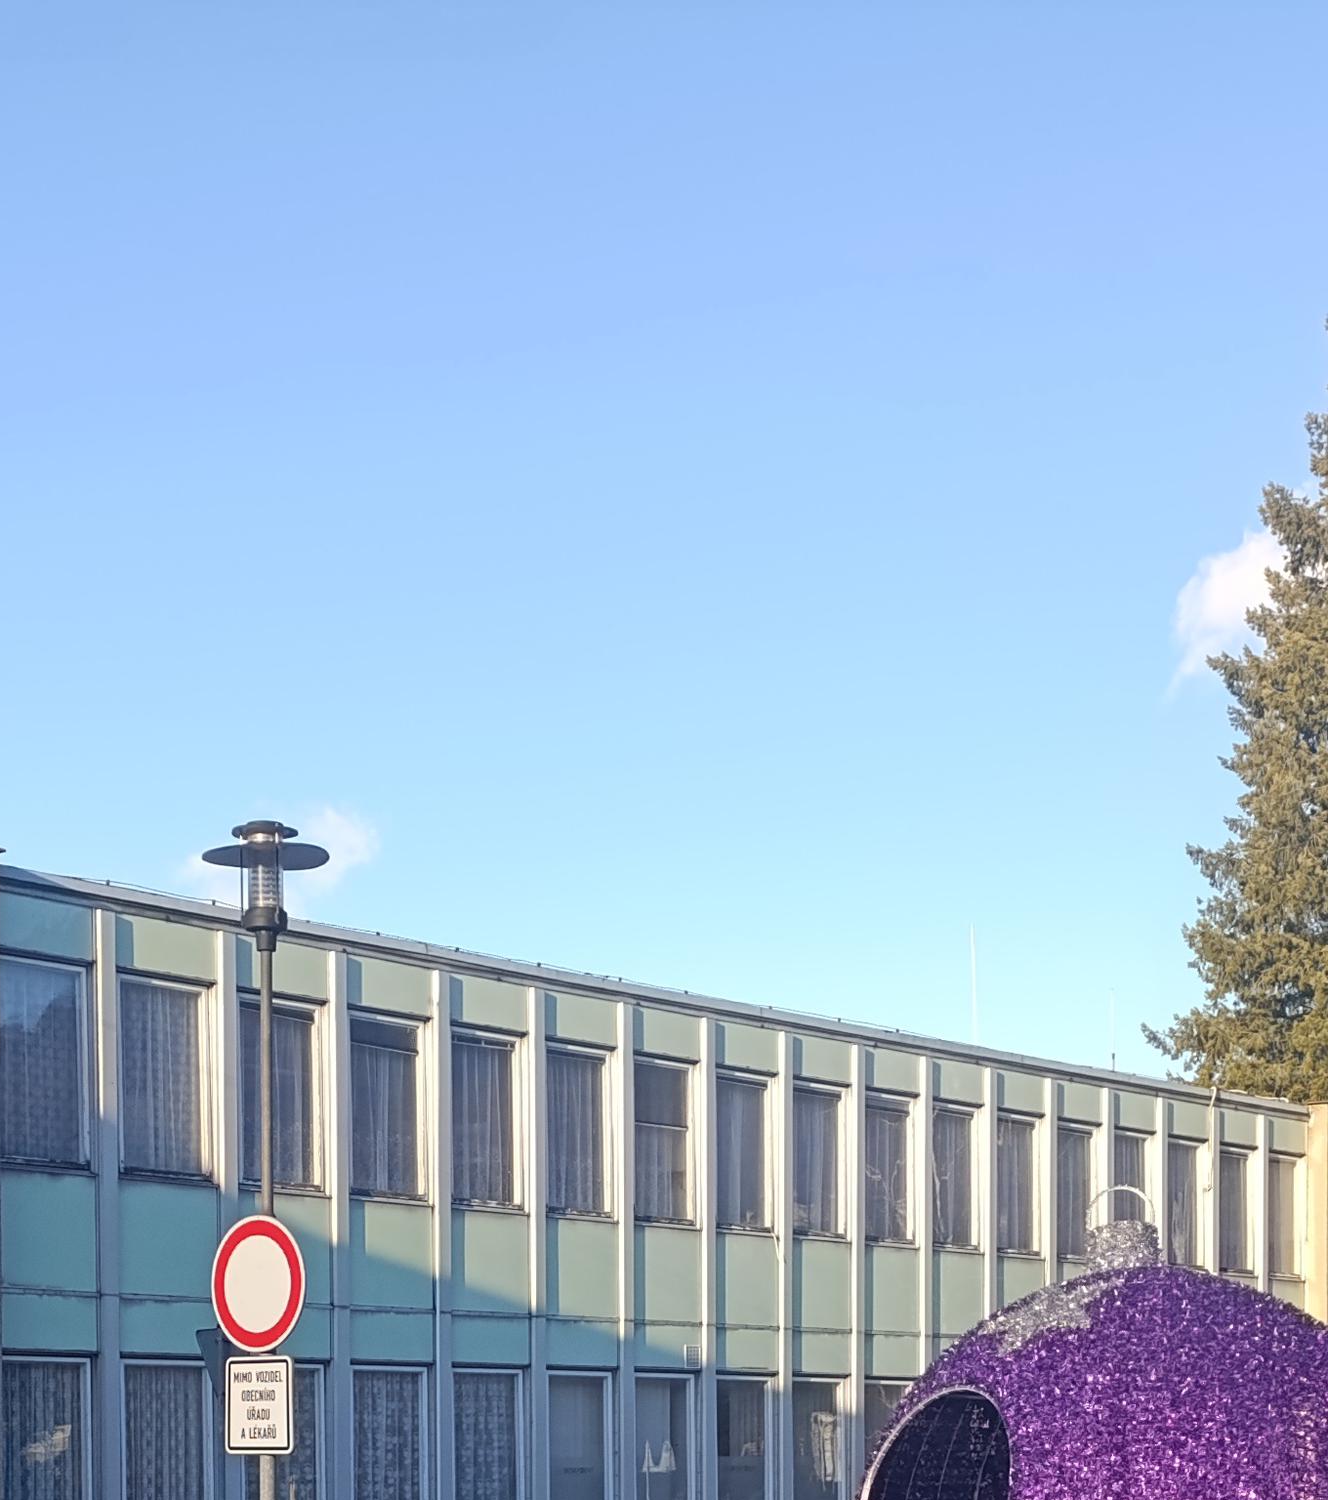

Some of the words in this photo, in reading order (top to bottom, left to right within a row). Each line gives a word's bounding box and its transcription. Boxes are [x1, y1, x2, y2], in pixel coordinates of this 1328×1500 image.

[233, 1371, 253, 1383] MIMO
[255, 1370, 283, 1383] VOZIDEL
[241, 1387, 276, 1402] OBECNÍHO
[246, 1406, 271, 1421] ÚŘADU
[240, 1427, 246, 1439] A
[249, 1423, 277, 1440] LÉKAŘŮ
